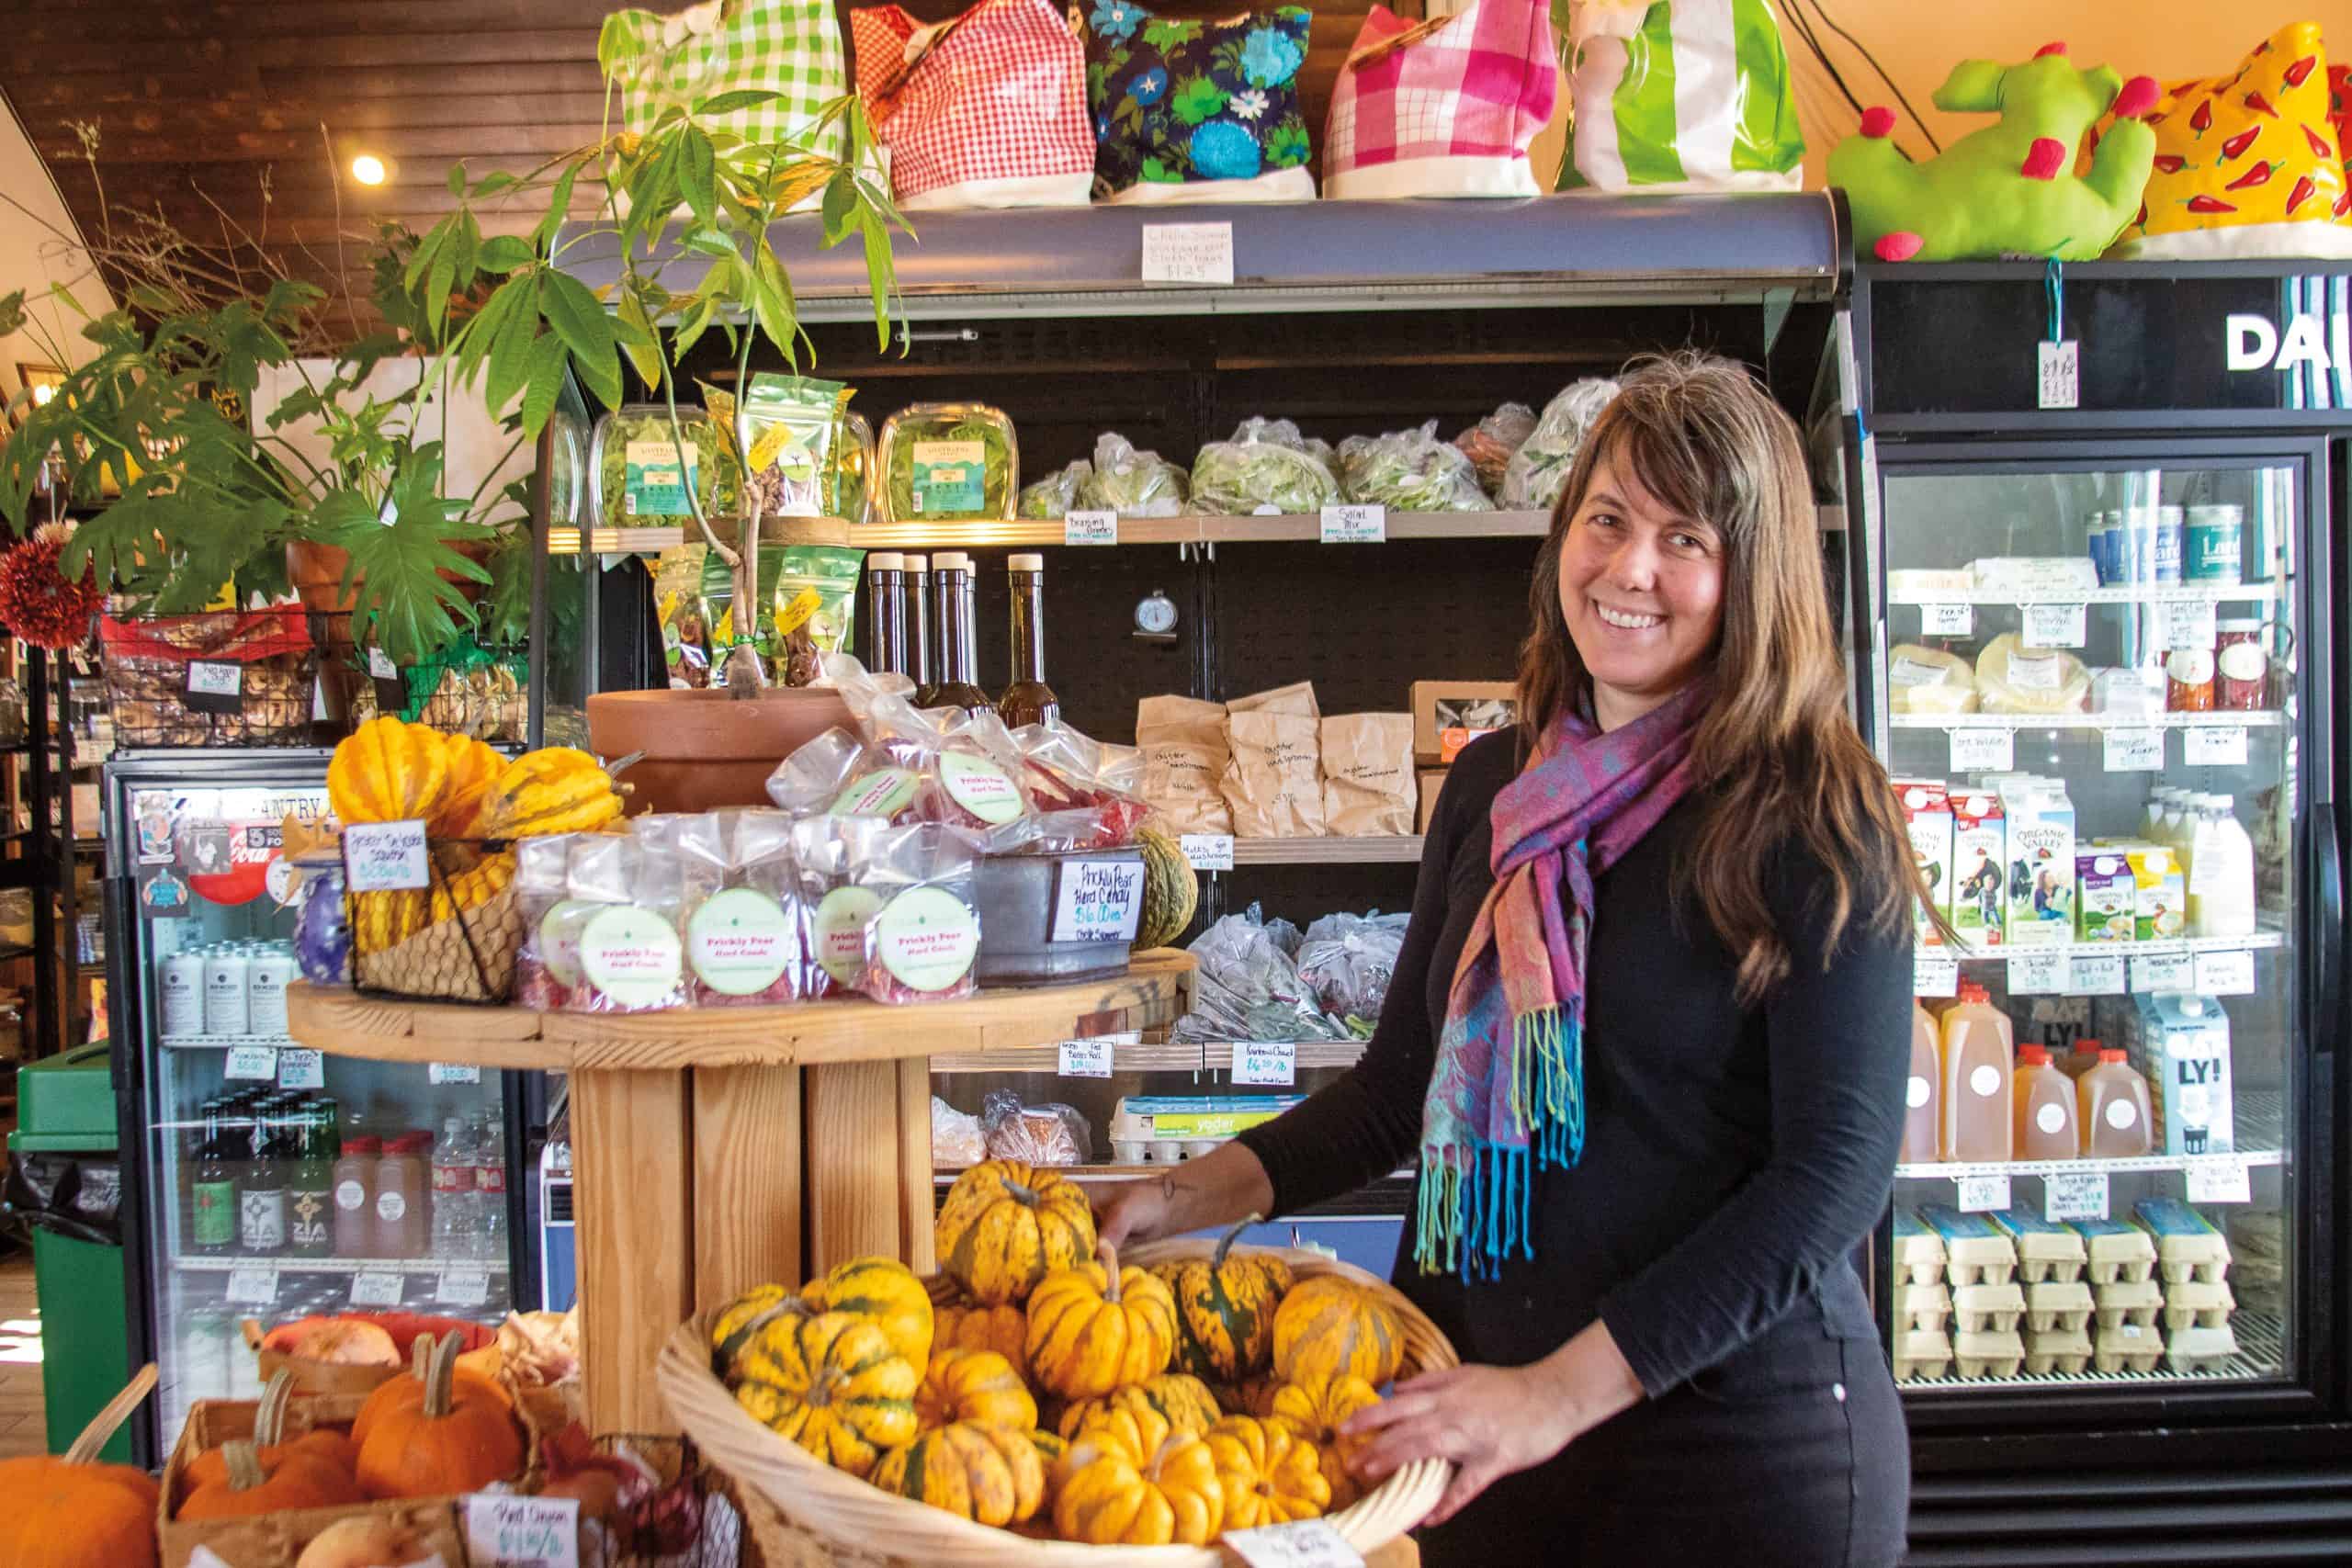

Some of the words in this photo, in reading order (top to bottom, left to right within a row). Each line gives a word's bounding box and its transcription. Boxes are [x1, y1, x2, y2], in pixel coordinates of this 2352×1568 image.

[2017, 829, 2066, 841] ORGANIC
[2022, 838, 2063, 851] VALLEY
[707, 937, 747, 948] Prickly
[750, 936, 775, 945] Pear
[898, 933, 935, 947] Prickly
[939, 931, 962, 942] Pear
[602, 948, 641, 959] Prickly
[715, 949, 738, 957] Hard
[907, 946, 929, 956] Hard
[2178, 1058, 2221, 1085] LY!
